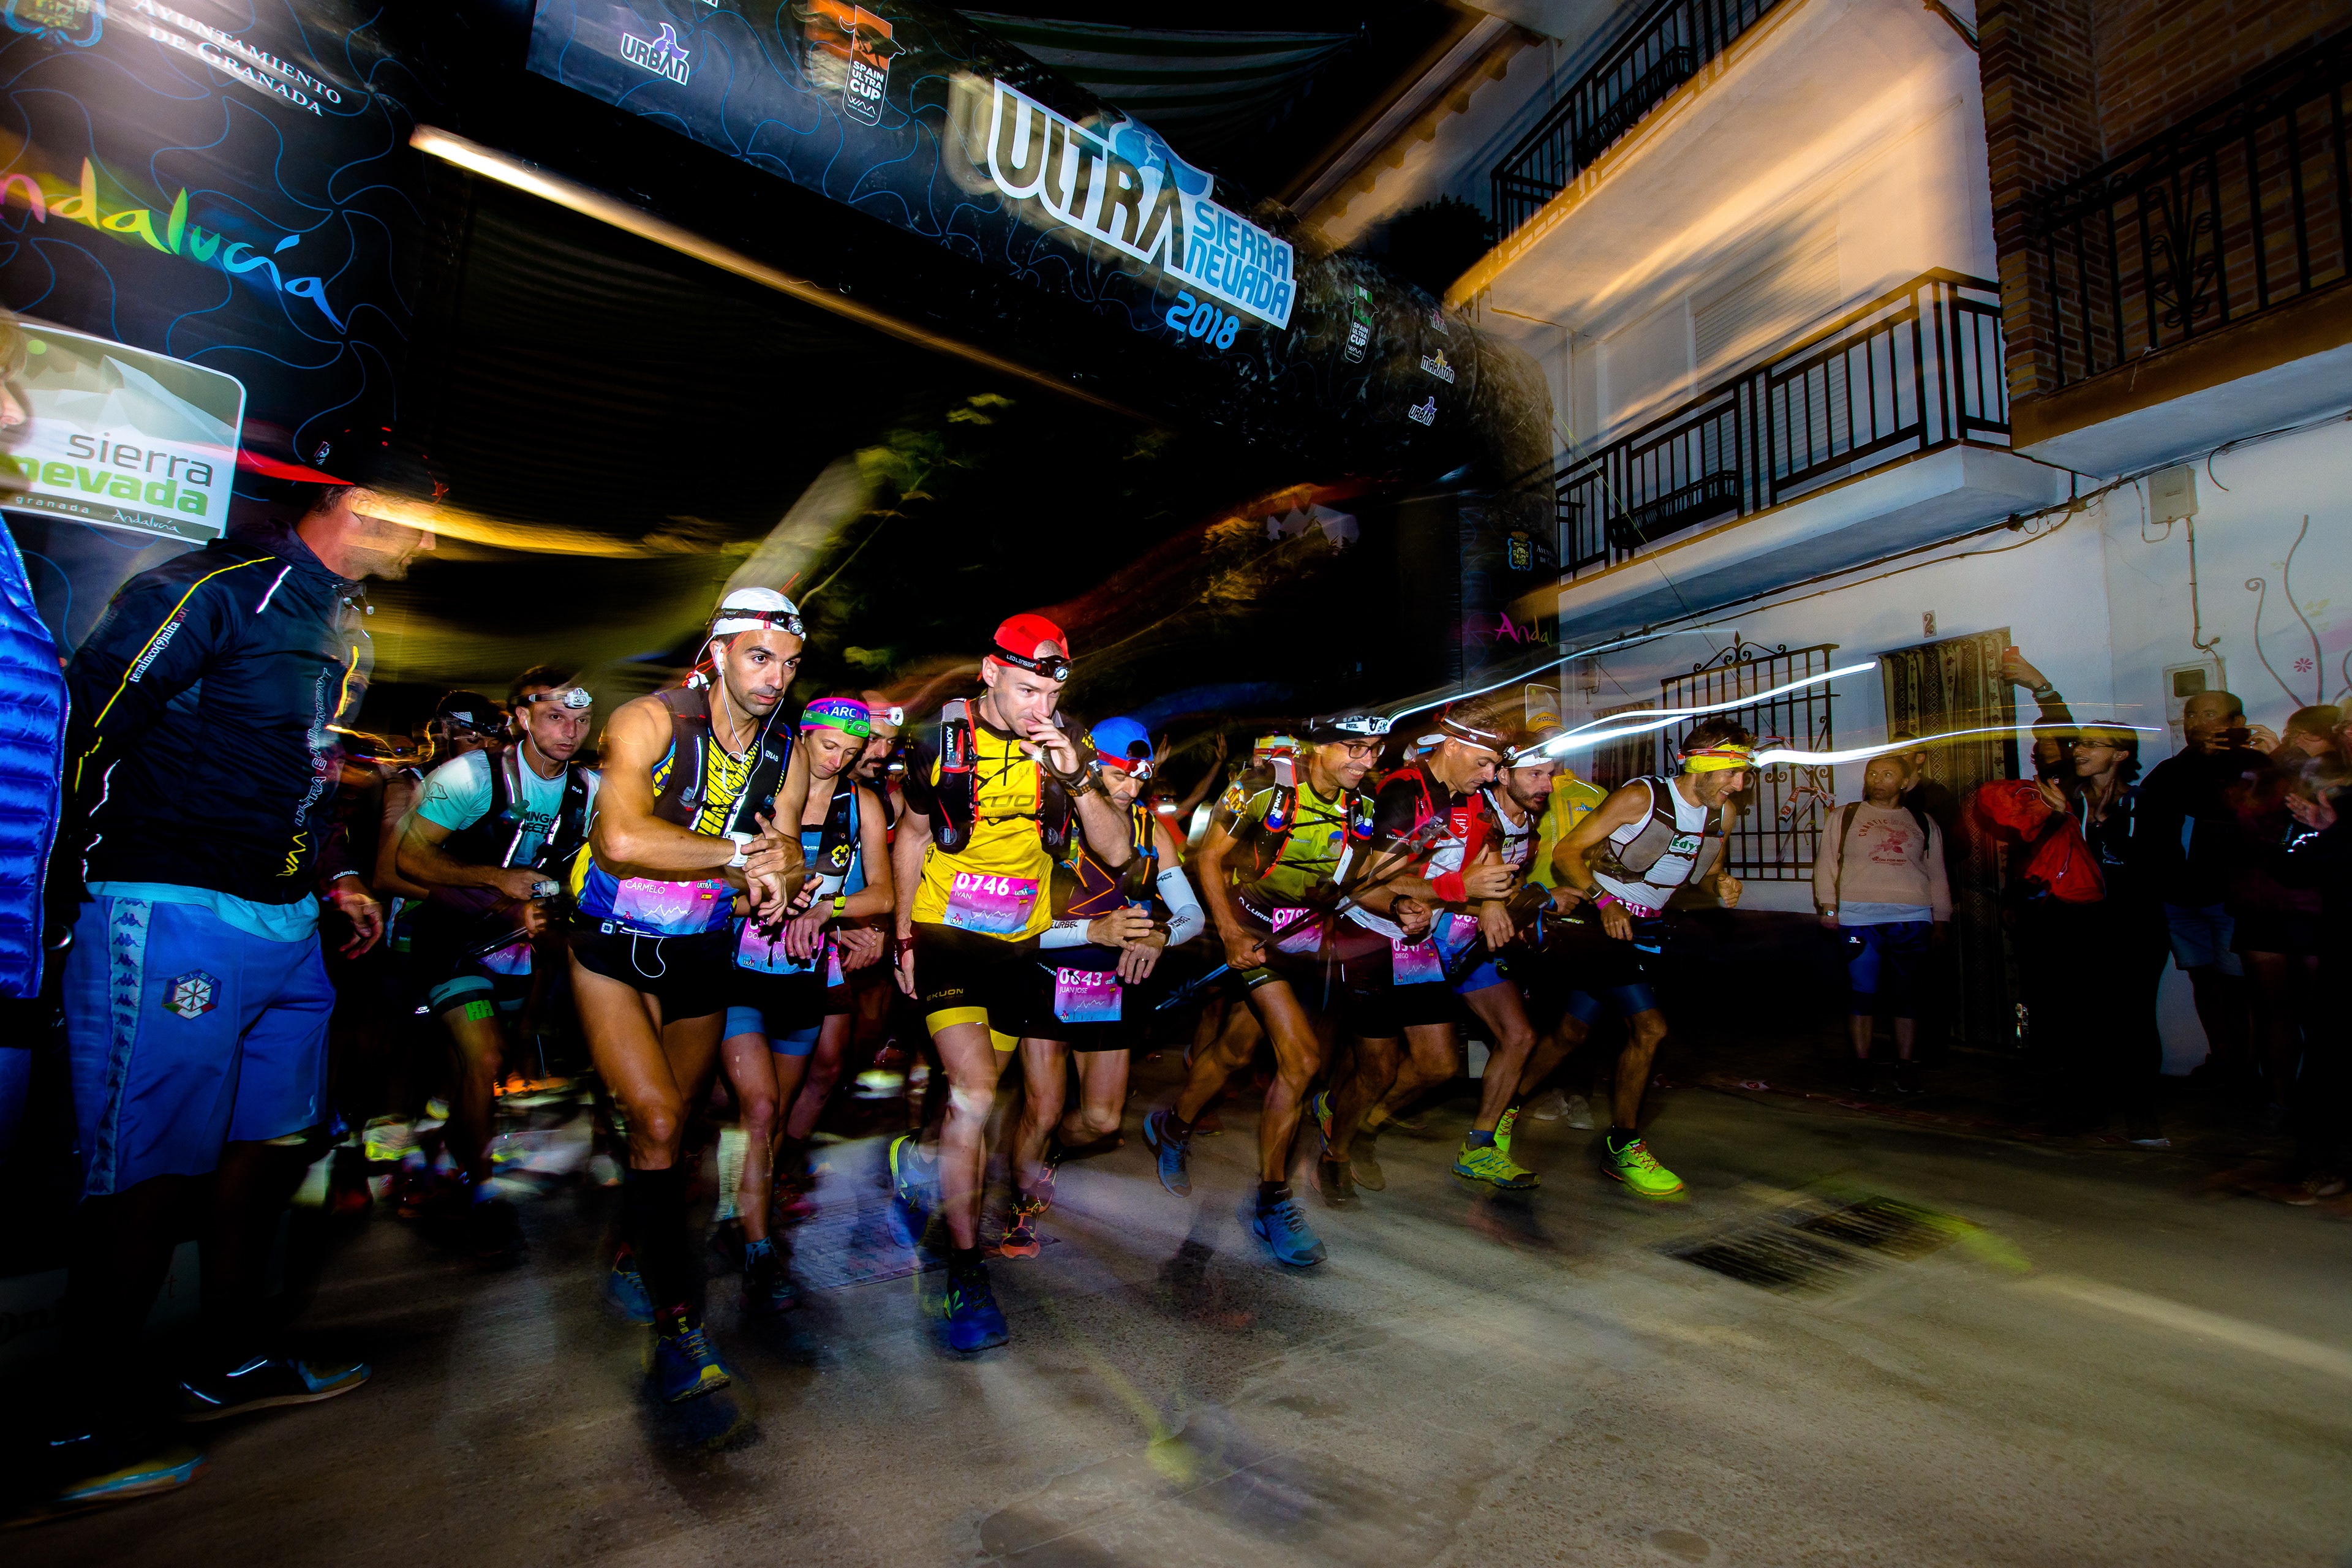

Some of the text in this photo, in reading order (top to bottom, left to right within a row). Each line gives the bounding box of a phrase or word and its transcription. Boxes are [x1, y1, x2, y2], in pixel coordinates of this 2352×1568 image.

[133, 0, 342, 104] AYUNTAMIENTO
[621, 34, 688, 84] URBAN
[148, 26, 323, 117] DE GRANADA
[851, 69, 883, 91] ULTRA
[853, 60, 884, 83] SPAIN
[850, 78, 881, 101] CUP
[995, 90, 1185, 271] ULTRA
[0, 156, 346, 330] ndalucía
[1193, 202, 1289, 281] SIERRA
[1185, 238, 1291, 320] NEVADA
[1165, 290, 1240, 350] 2018
[1352, 322, 1369, 334] SPAIN
[1350, 334, 1366, 347] CUP
[1351, 328, 1367, 339] ULTRA
[1409, 404, 1434, 426] URBAN
[66, 432, 214, 488] sierra
[16, 495, 182, 534] granada Andalucía
[1923, 613, 1934, 635] 2
[1858, 819, 1888, 837] CHAOTIC
[625, 880, 666, 894] CARMELO
[696, 881, 712, 890] ULTRA
[954, 890, 973, 900] IVAN
[956, 872, 1009, 896] 0746
[742, 959, 755, 968] TRAIL
[1058, 968, 1102, 986] 0643
[926, 988, 964, 1001] EKUON
[1059, 986, 1075, 995] JUAN
